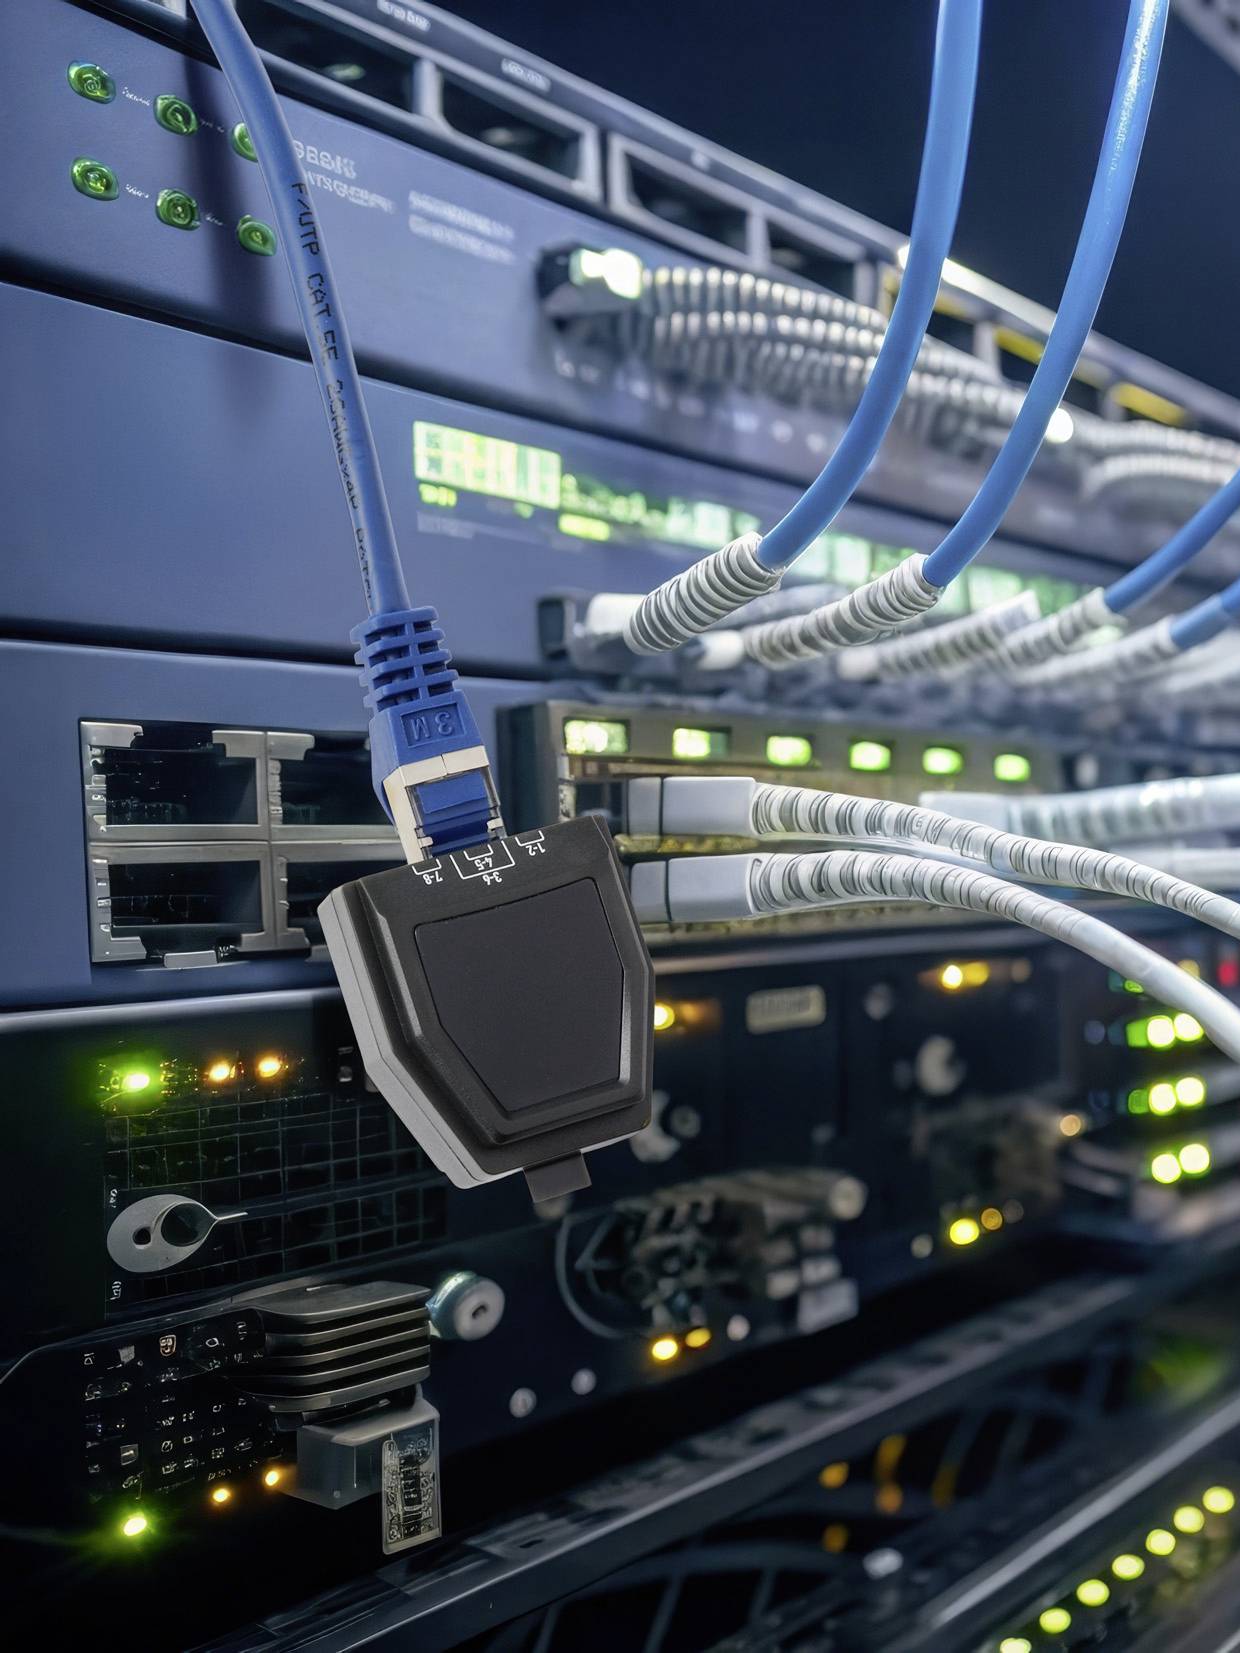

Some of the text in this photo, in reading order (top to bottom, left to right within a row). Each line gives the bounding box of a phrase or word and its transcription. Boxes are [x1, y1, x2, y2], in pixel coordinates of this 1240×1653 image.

[525, 842, 546, 857] 1-2
[474, 856, 493, 871] 4-5
[422, 870, 443, 885] 7-8
[482, 871, 503, 886] 3-6
